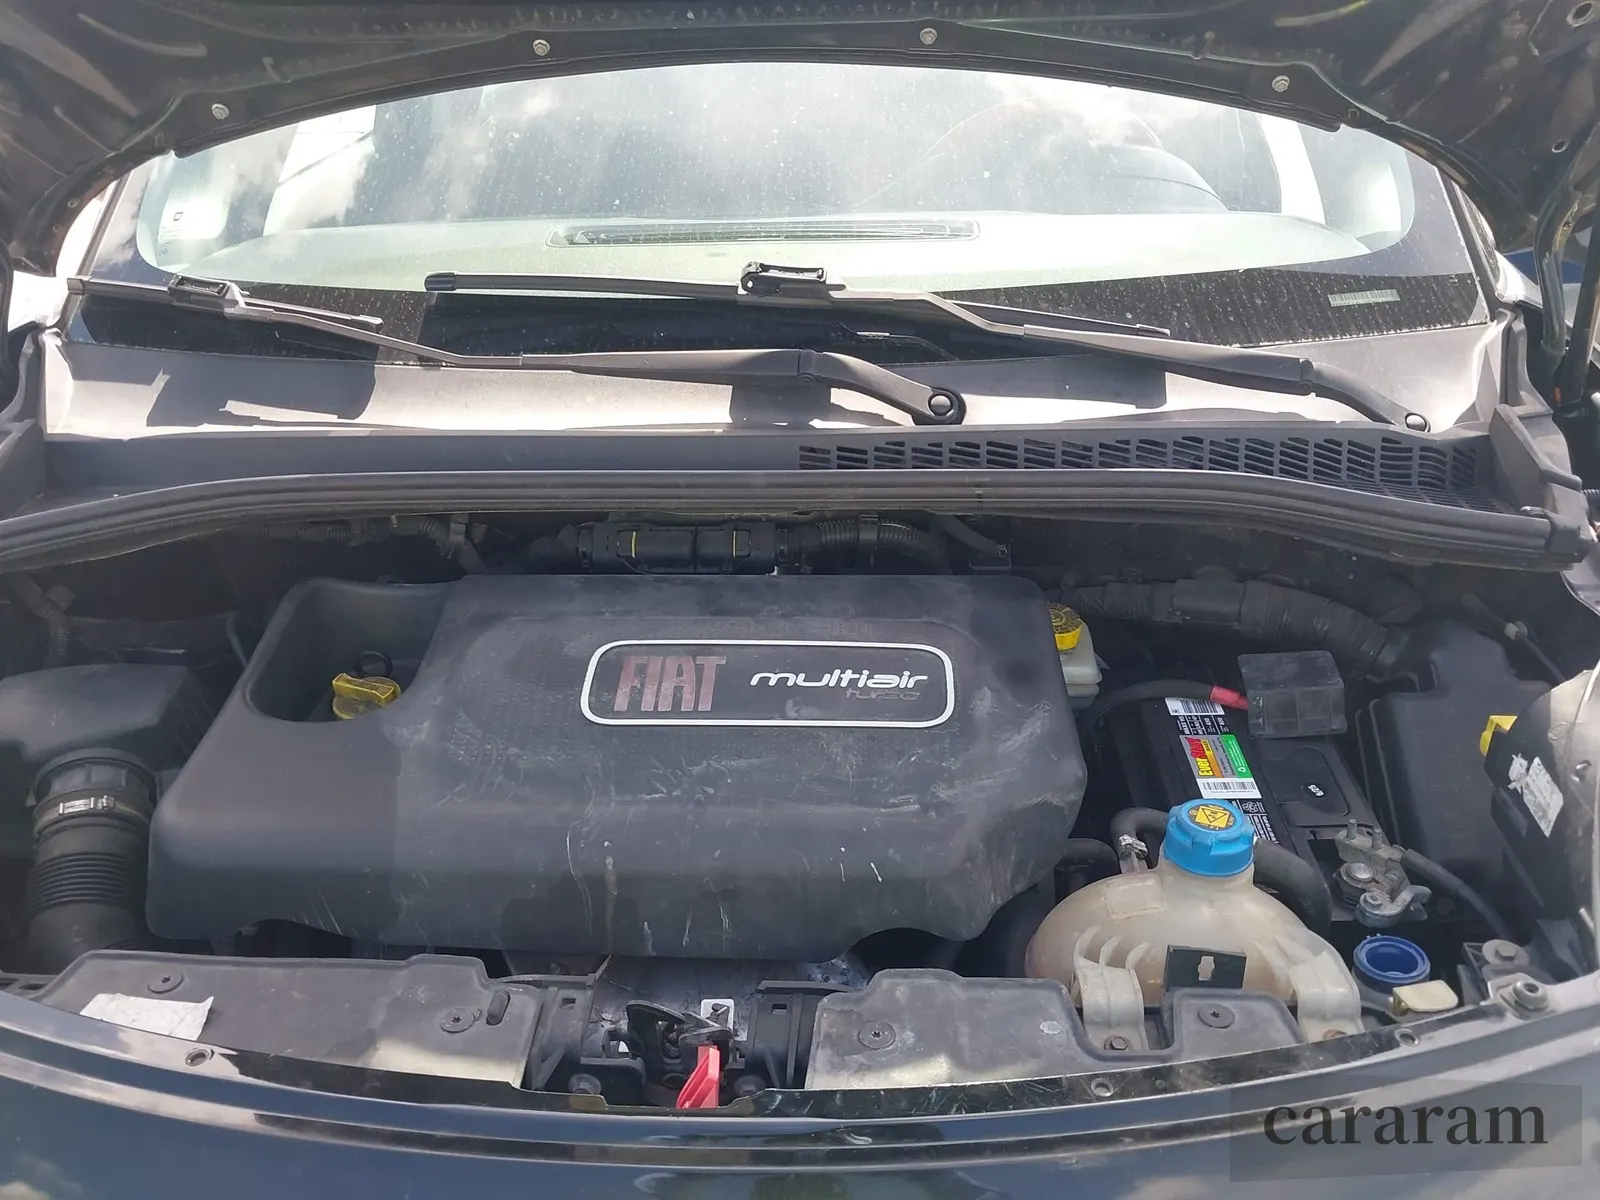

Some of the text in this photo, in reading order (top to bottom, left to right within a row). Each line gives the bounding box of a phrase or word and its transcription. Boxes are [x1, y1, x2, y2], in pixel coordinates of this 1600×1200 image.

[613, 656, 727, 711] FIAT
[750, 669, 928, 688] multiair
[845, 689, 921, 700] turbo
[1185, 737, 1213, 776] EverStart
